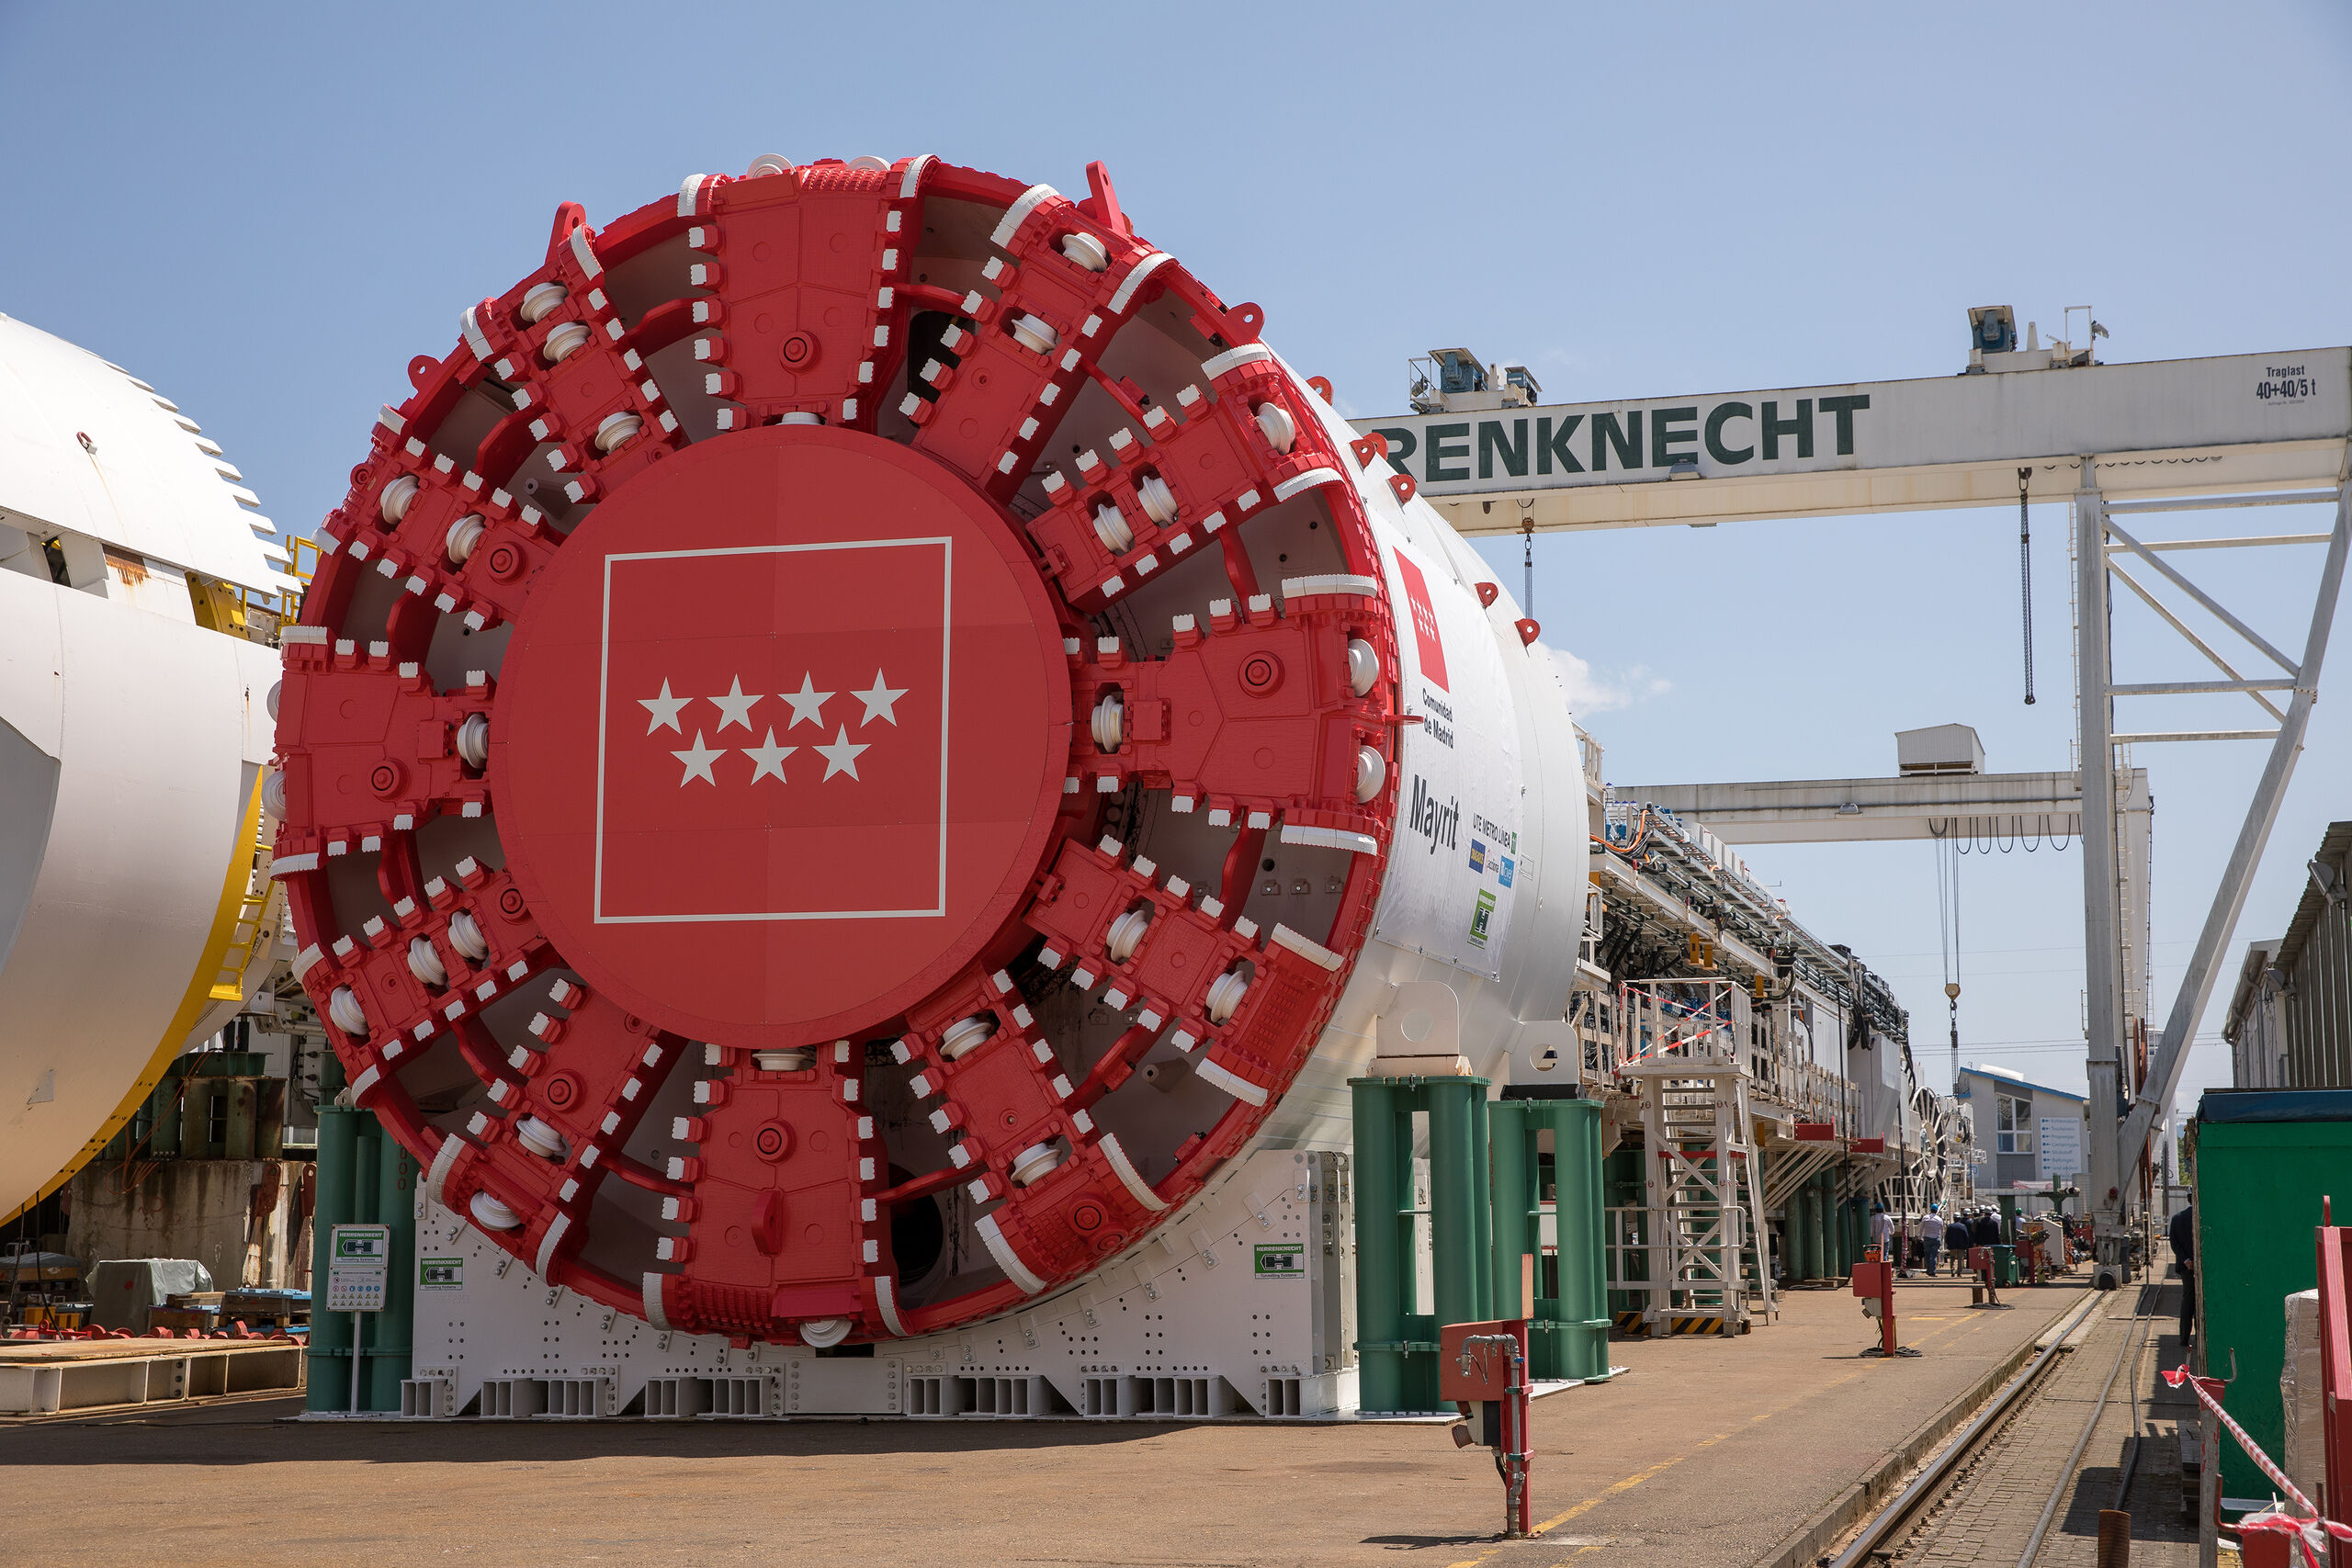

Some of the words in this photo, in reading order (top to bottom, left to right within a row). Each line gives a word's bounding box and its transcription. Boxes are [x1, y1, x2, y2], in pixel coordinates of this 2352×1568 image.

[2266, 365, 2305, 378] Traglast
[2256, 378, 2308, 400] 40+40/5
[2311, 378, 2316, 396] t
[1422, 687, 1453, 724] Comunidad
[1423, 714, 1432, 734] de
[1432, 718, 1454, 750] Madrid
[1409, 773, 1461, 855] Mayrit
[1473, 812, 1482, 832] UTE
[1482, 818, 1498, 841] METRO
